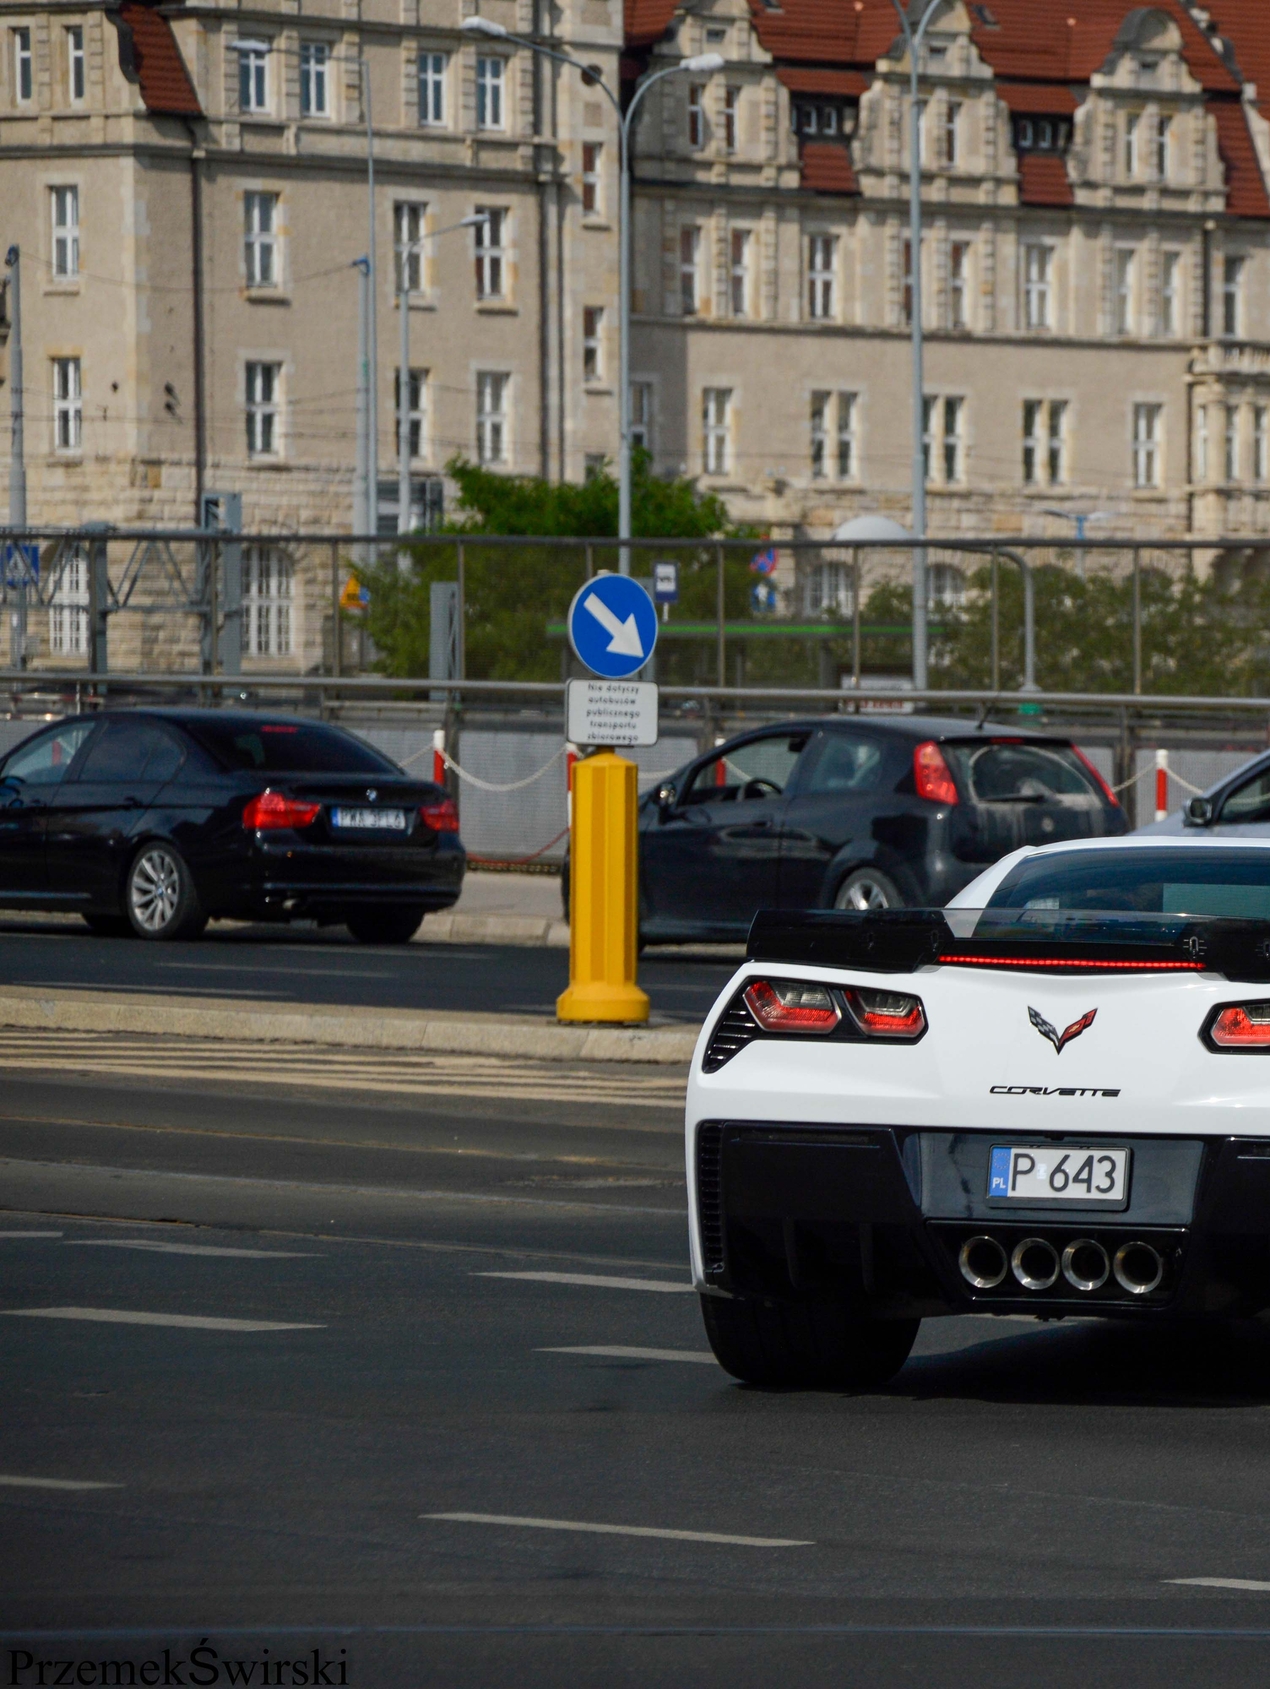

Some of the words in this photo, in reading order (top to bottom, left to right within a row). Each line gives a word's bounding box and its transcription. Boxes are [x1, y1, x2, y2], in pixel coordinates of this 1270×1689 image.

[588, 682, 603, 692] Nie
[606, 683, 640, 695] dotyczy
[588, 696, 636, 705] autobusów
[586, 707, 641, 719] publicznego
[589, 720, 637, 731] transportu
[587, 732, 639, 744] zbiorowego
[989, 1085, 1122, 1098] CORVETTE
[1011, 1153, 1036, 1192] P
[1049, 1153, 1117, 1194] 643
[992, 1177, 1006, 1189] PL
